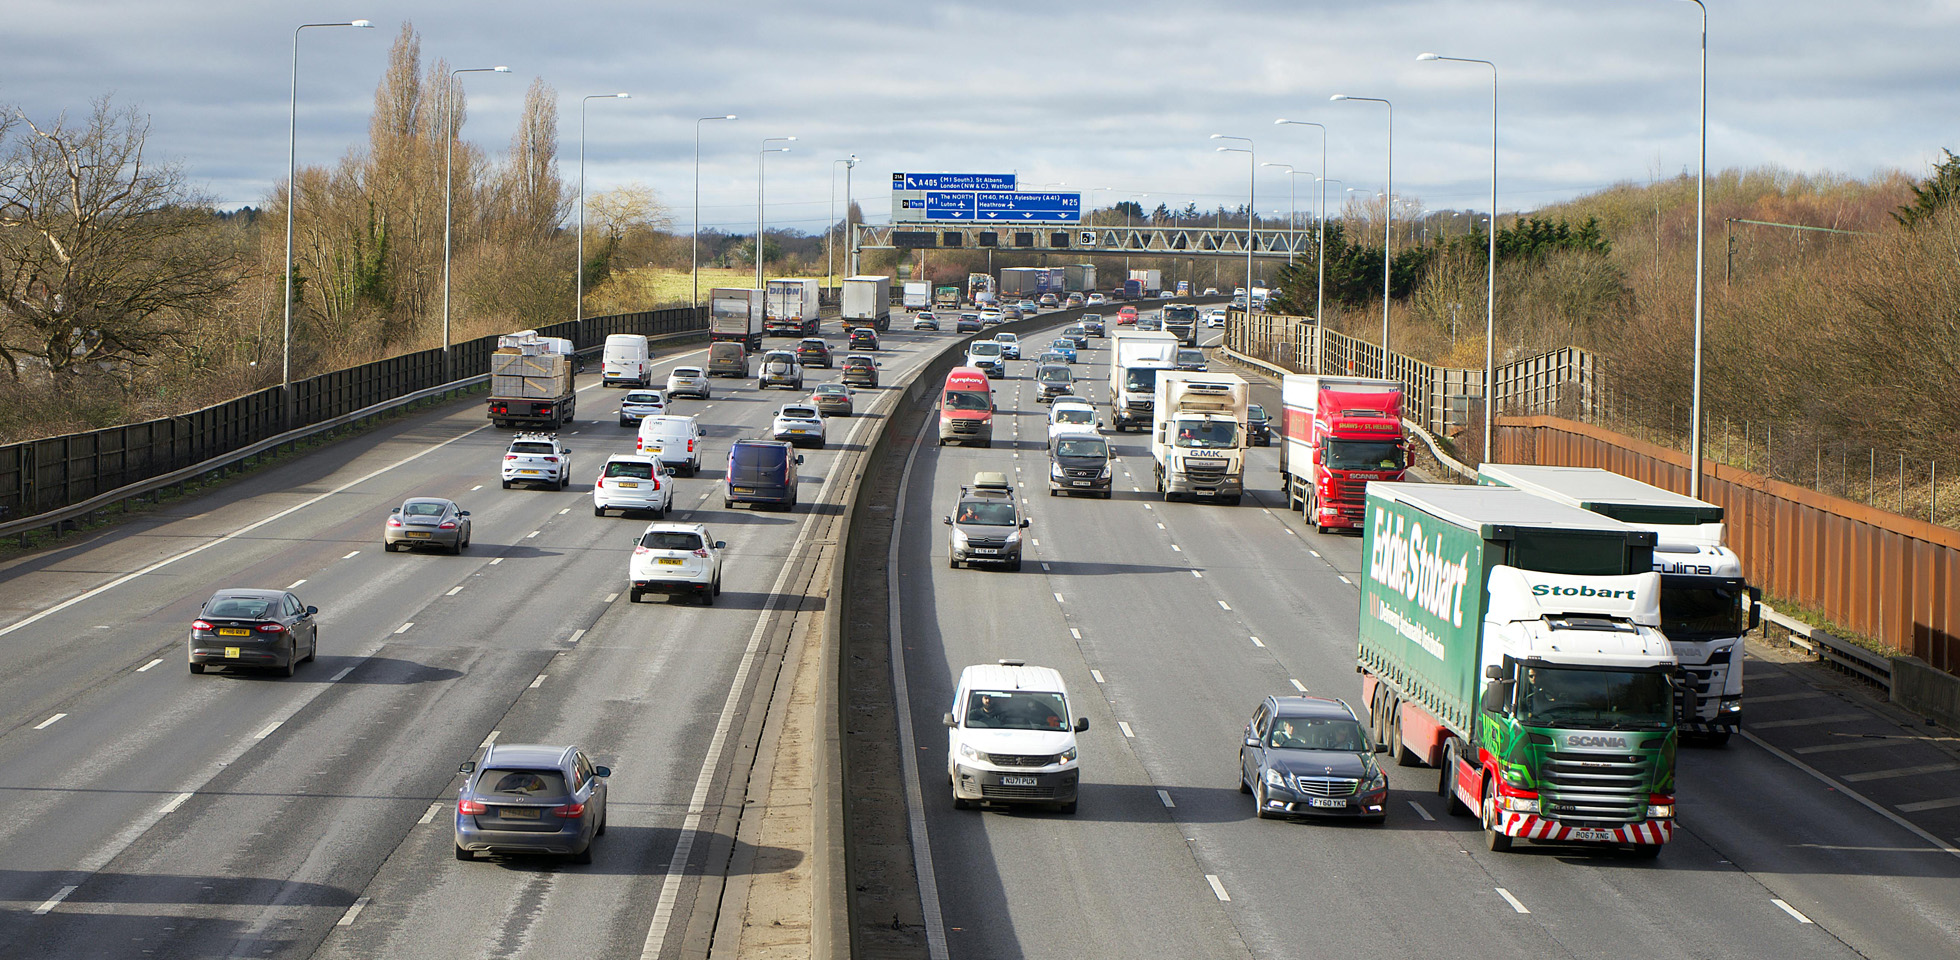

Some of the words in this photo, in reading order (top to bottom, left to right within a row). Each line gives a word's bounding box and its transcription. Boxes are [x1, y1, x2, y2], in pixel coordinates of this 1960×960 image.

[918, 179, 938, 187] A405
[928, 197, 938, 205] M1
[1062, 198, 1078, 206] M25
[769, 287, 800, 295] DIXON
[951, 376, 983, 384] symphony
[1371, 506, 1409, 596] Eddie
[1406, 521, 1468, 628] Stobart
[1532, 584, 1636, 600] Stobart
[1567, 735, 1627, 748] SCANIA
[1314, 798, 1332, 806] FY60
[1595, 832, 1609, 840] XNG
